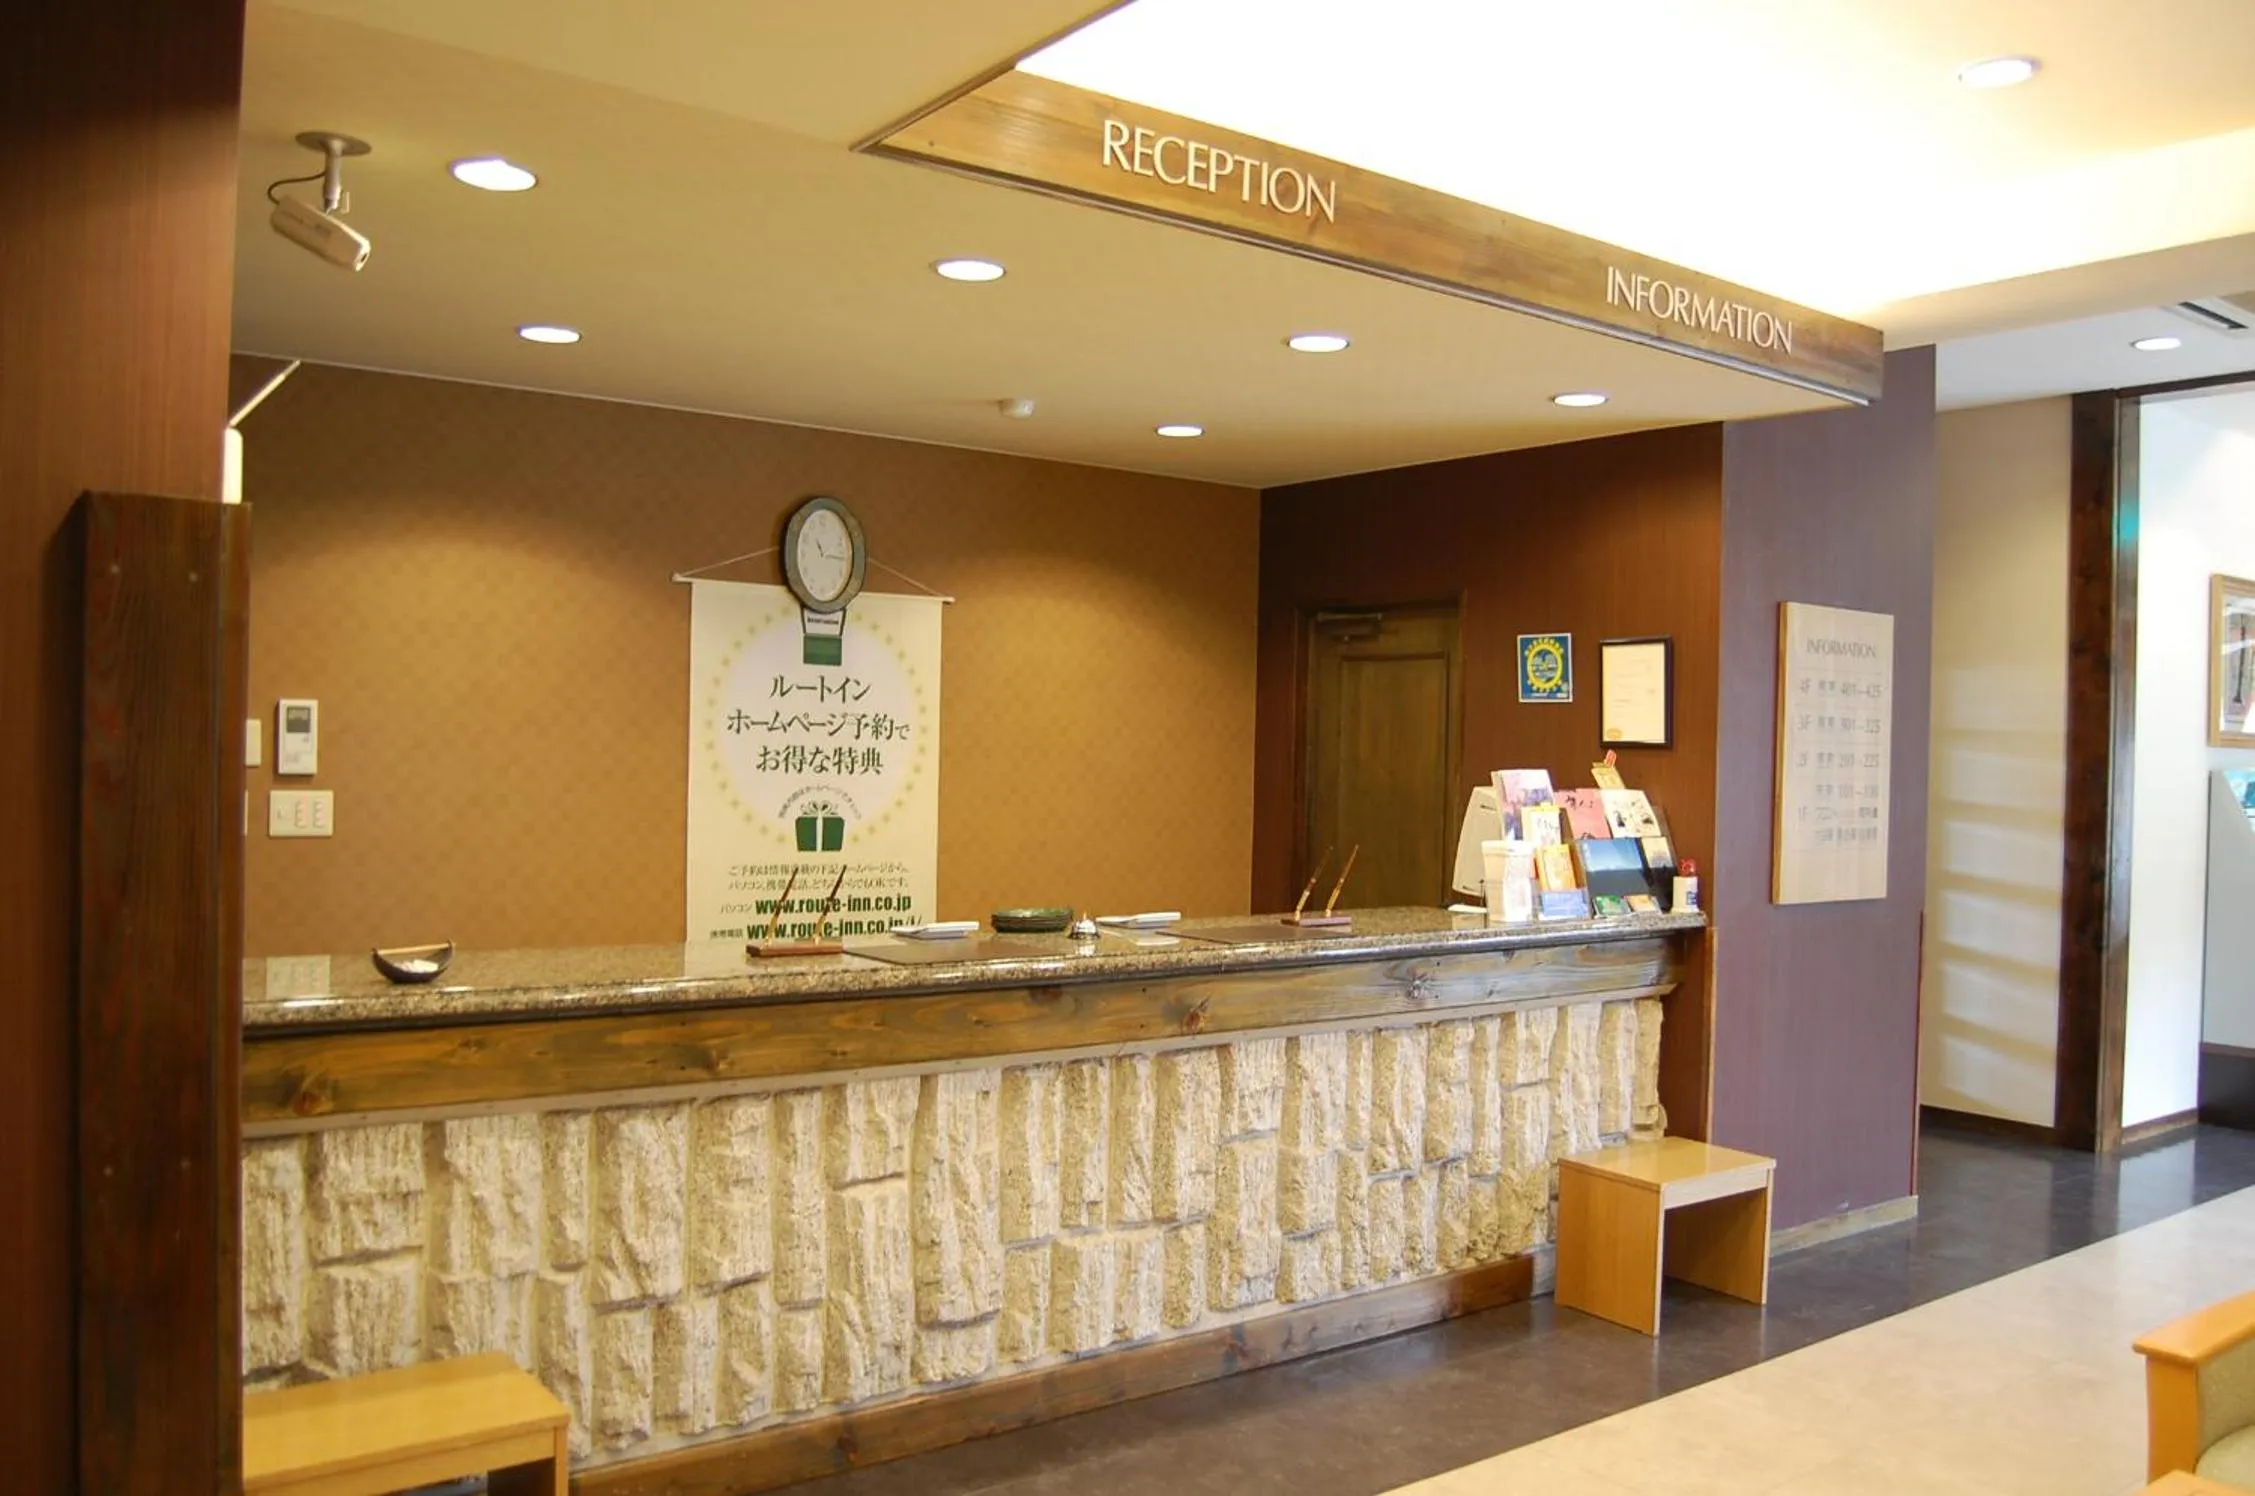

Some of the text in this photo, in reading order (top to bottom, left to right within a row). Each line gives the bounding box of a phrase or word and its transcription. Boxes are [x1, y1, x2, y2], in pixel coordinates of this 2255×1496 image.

[1102, 119, 1336, 223] RECEPTION
[1606, 265, 1792, 355] INFORMATION
[1806, 638, 1877, 659] INFORMATION
[769, 674, 872, 704] ルートイン
[727, 708, 911, 741] ホームページ予約で
[755, 744, 884, 776] お得な特典
